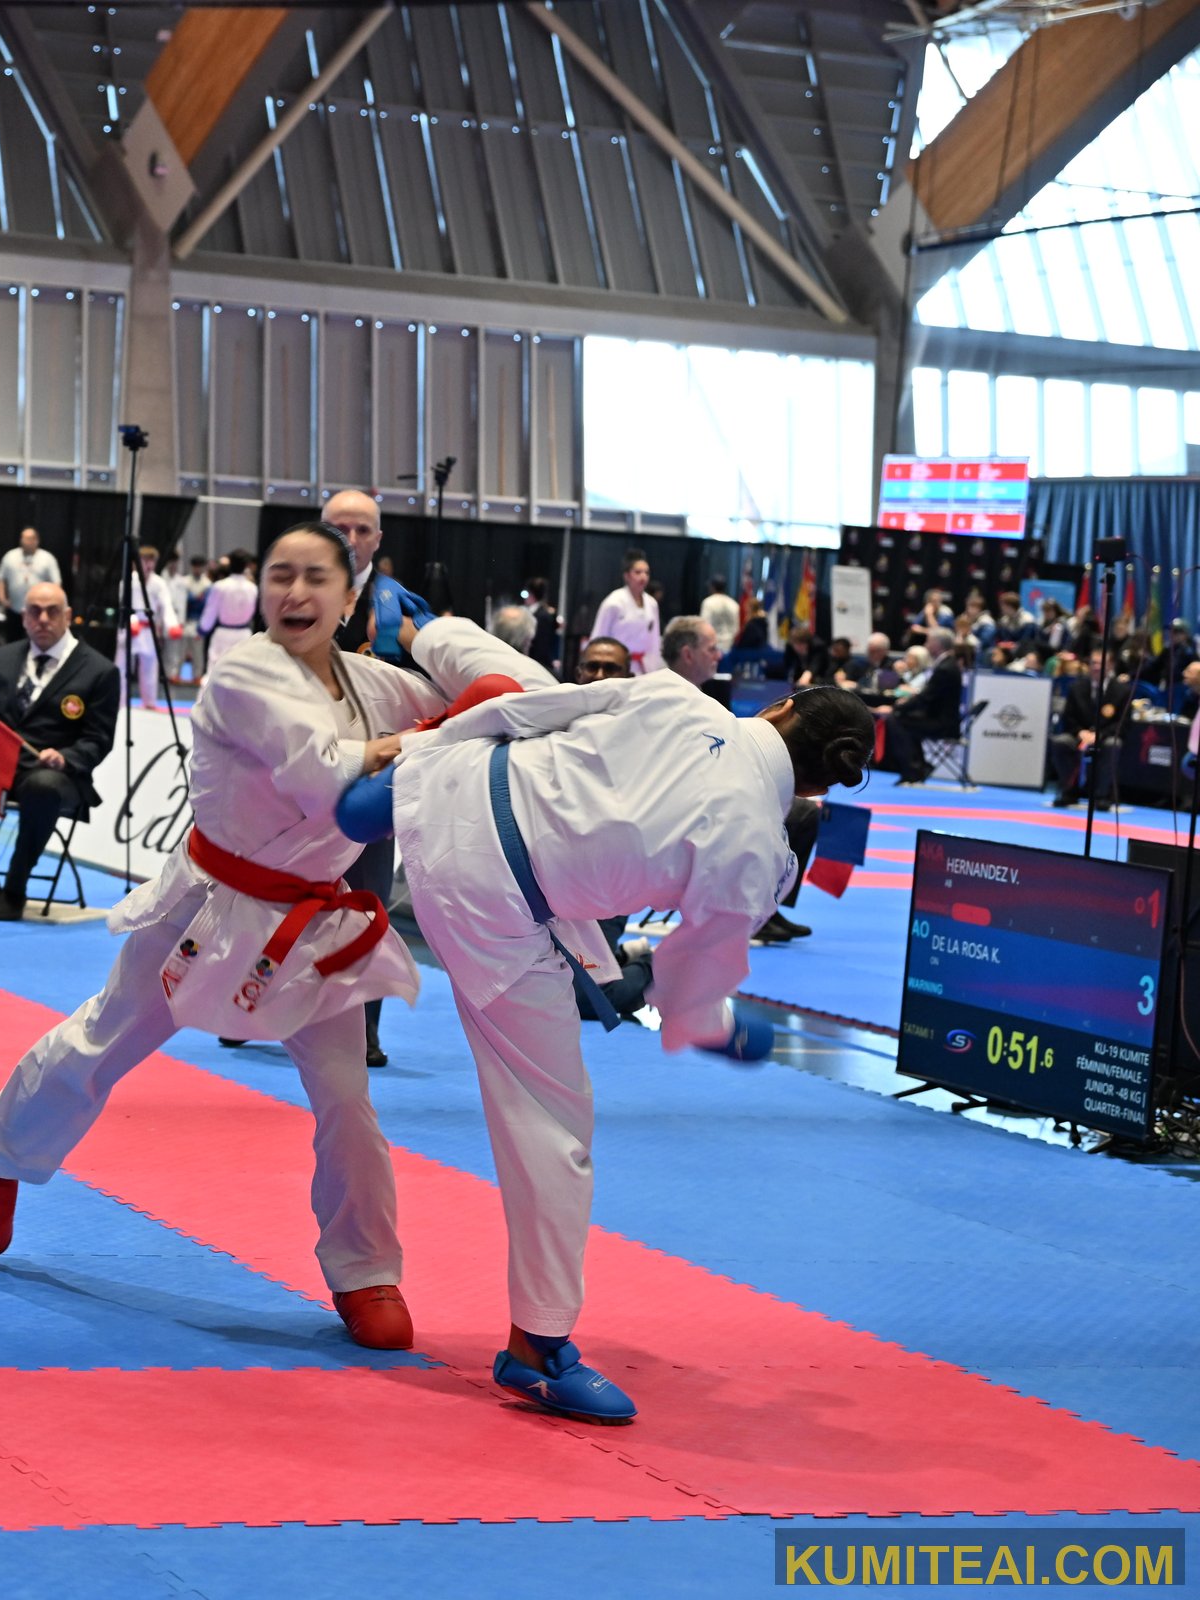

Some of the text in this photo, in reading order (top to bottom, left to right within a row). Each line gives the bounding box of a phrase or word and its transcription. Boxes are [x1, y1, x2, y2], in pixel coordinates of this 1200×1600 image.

[946, 857, 1020, 885] HERNANDEZ V.
[1148, 889, 1161, 928] 1
[911, 919, 930, 938] AO
[932, 934, 945, 952] DE
[947, 938, 959, 955] LA
[961, 941, 989, 961] ROSA
[907, 977, 943, 995] WARNING
[1137, 975, 1155, 1016] 3
[903, 1022, 929, 1039] TATAMI
[1076, 1054, 1142, 1084] FÉMININ/FEMALE
[1119, 1048, 1150, 1066] KUMITE
[1084, 1078, 1114, 1096] JUNIOR
[1129, 1090, 1141, 1104] KG
[1083, 1097, 1146, 1125] QUARTER-FINAL
